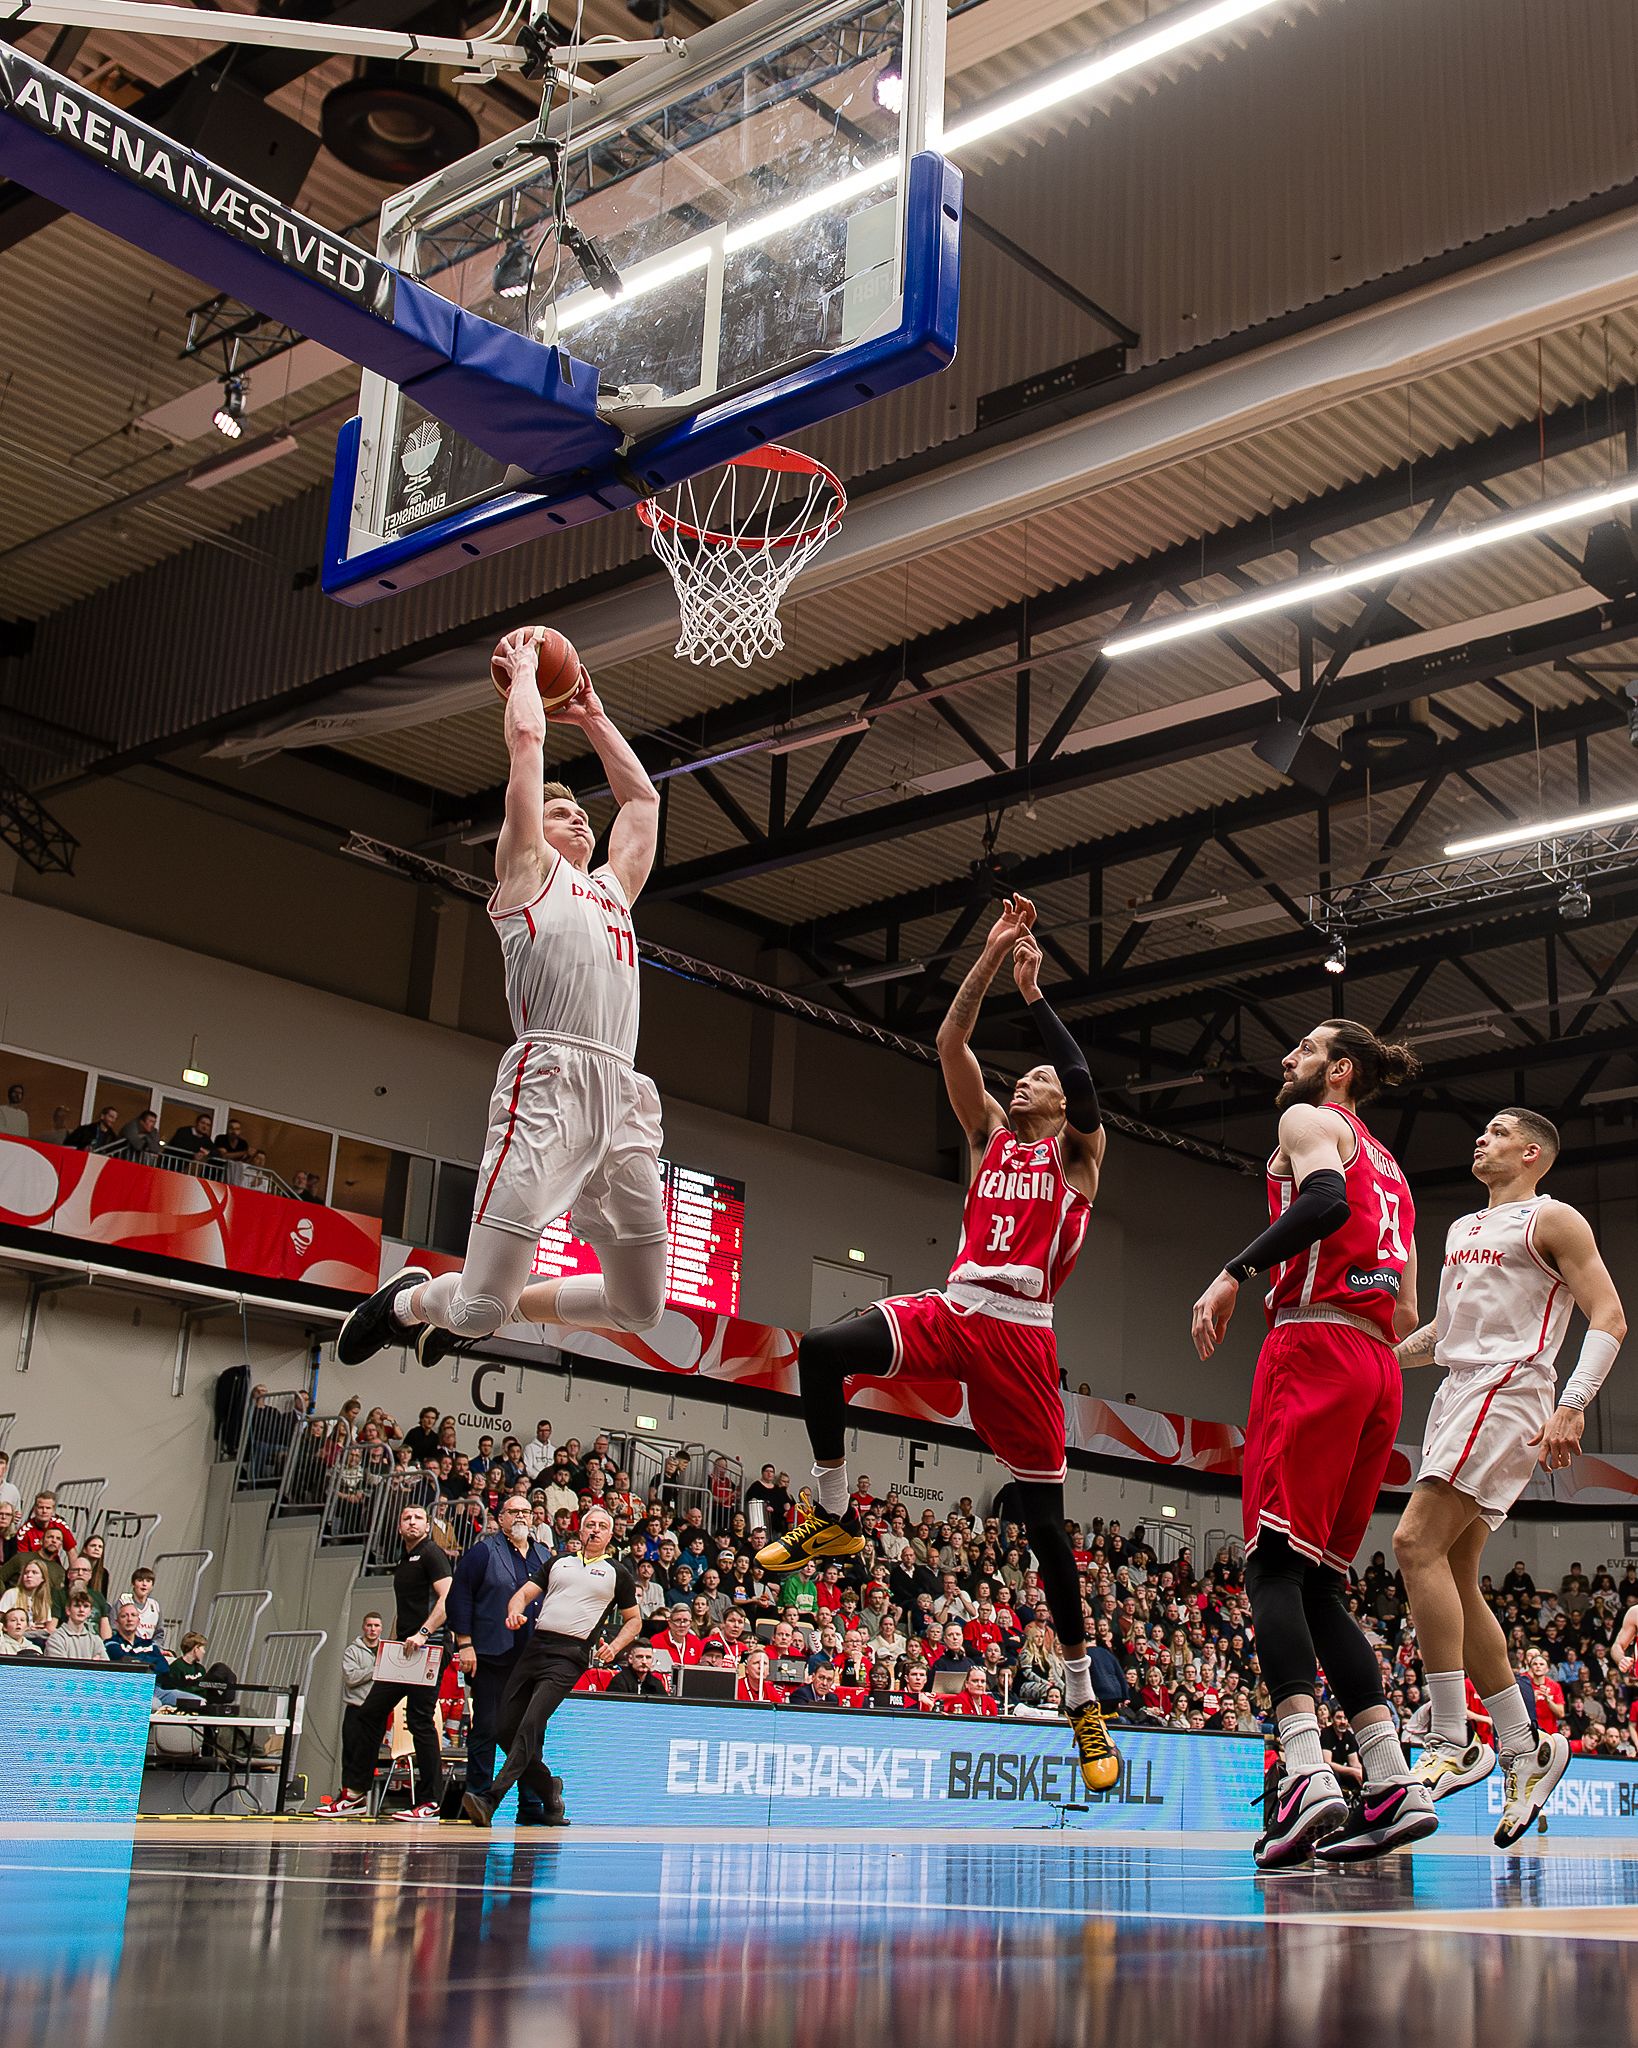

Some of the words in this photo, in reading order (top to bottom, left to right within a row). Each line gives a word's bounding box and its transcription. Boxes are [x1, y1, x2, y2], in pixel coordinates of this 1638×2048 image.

[14, 77, 177, 194] ARENA
[181, 164, 366, 293] NÆSTVED
[606, 925, 634, 968] 11
[986, 1213, 1016, 1252] 32
[1443, 1248, 1506, 1268] ANMARK
[471, 1362, 506, 1416] G
[457, 1412, 512, 1433] GLUMSØ
[908, 1440, 929, 1484] F
